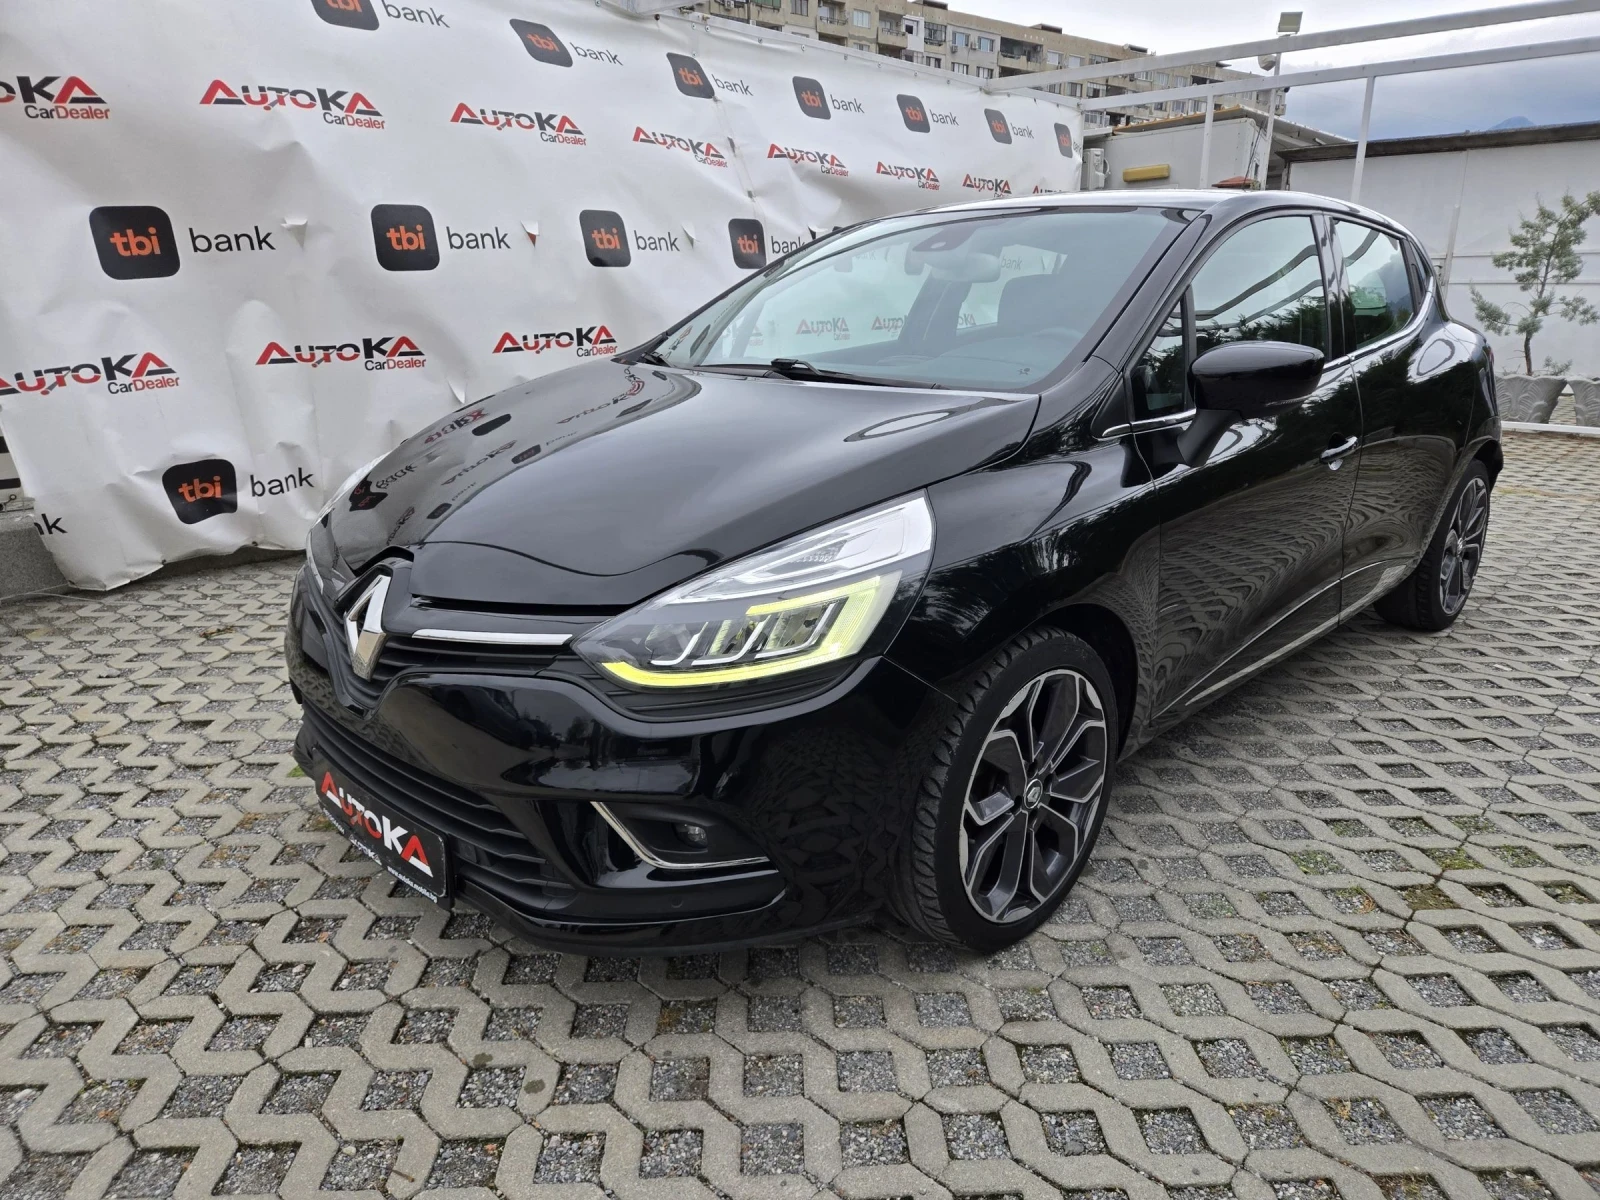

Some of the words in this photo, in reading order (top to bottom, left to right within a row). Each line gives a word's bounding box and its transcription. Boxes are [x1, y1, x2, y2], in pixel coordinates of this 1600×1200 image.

[381, 0, 450, 28] bank
[526, 33, 560, 52] tbi
[569, 41, 623, 66] bank
[678, 67, 703, 86] tbi
[712, 74, 753, 96] bank
[24, 104, 110, 119] CarDealer
[801, 90, 822, 107] tbi
[830, 94, 865, 114] bank
[322, 111, 385, 130] CarDealer
[905, 106, 923, 122] tbi
[929, 109, 959, 126] bank
[540, 131, 587, 146] CarDealer
[991, 120, 1007, 135] tbi
[1010, 122, 1035, 139] bank
[694, 154, 728, 168] CarDealer
[820, 164, 849, 177] CarDealer
[917, 180, 941, 191] CarDealer
[109, 227, 162, 257] tbi
[189, 226, 276, 253] bank
[386, 224, 426, 251] tbi
[446, 226, 512, 250] bank
[591, 227, 621, 250] tbi
[633, 229, 680, 252] bank
[737, 234, 759, 255] tbi
[576, 344, 618, 358] CarDealer
[364, 358, 427, 371] CarDealer
[107, 375, 180, 395] CarDealer
[177, 475, 222, 503] tbi
[249, 467, 315, 497] bank
